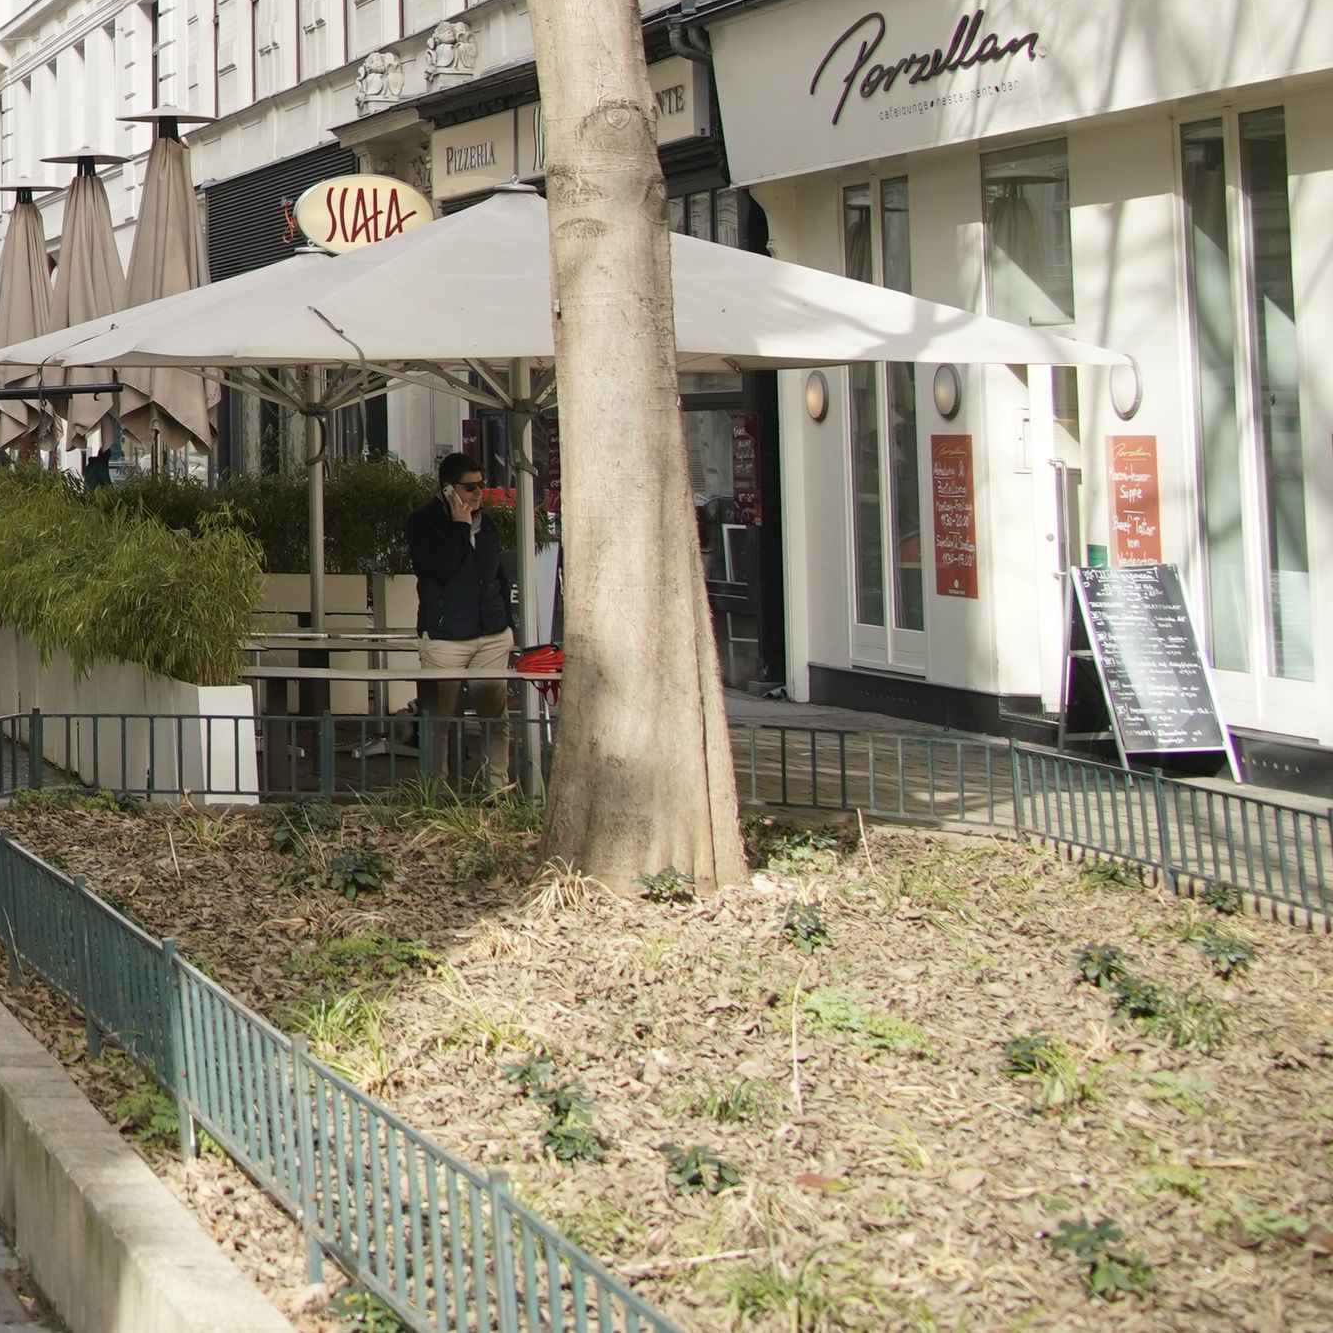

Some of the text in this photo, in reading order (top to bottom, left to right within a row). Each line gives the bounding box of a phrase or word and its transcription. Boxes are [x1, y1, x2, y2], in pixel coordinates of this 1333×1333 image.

[810, 11, 1039, 125] Porzellan
[446, 141, 496, 175] PIZZERIA
[325, 187, 417, 243] SCALA
